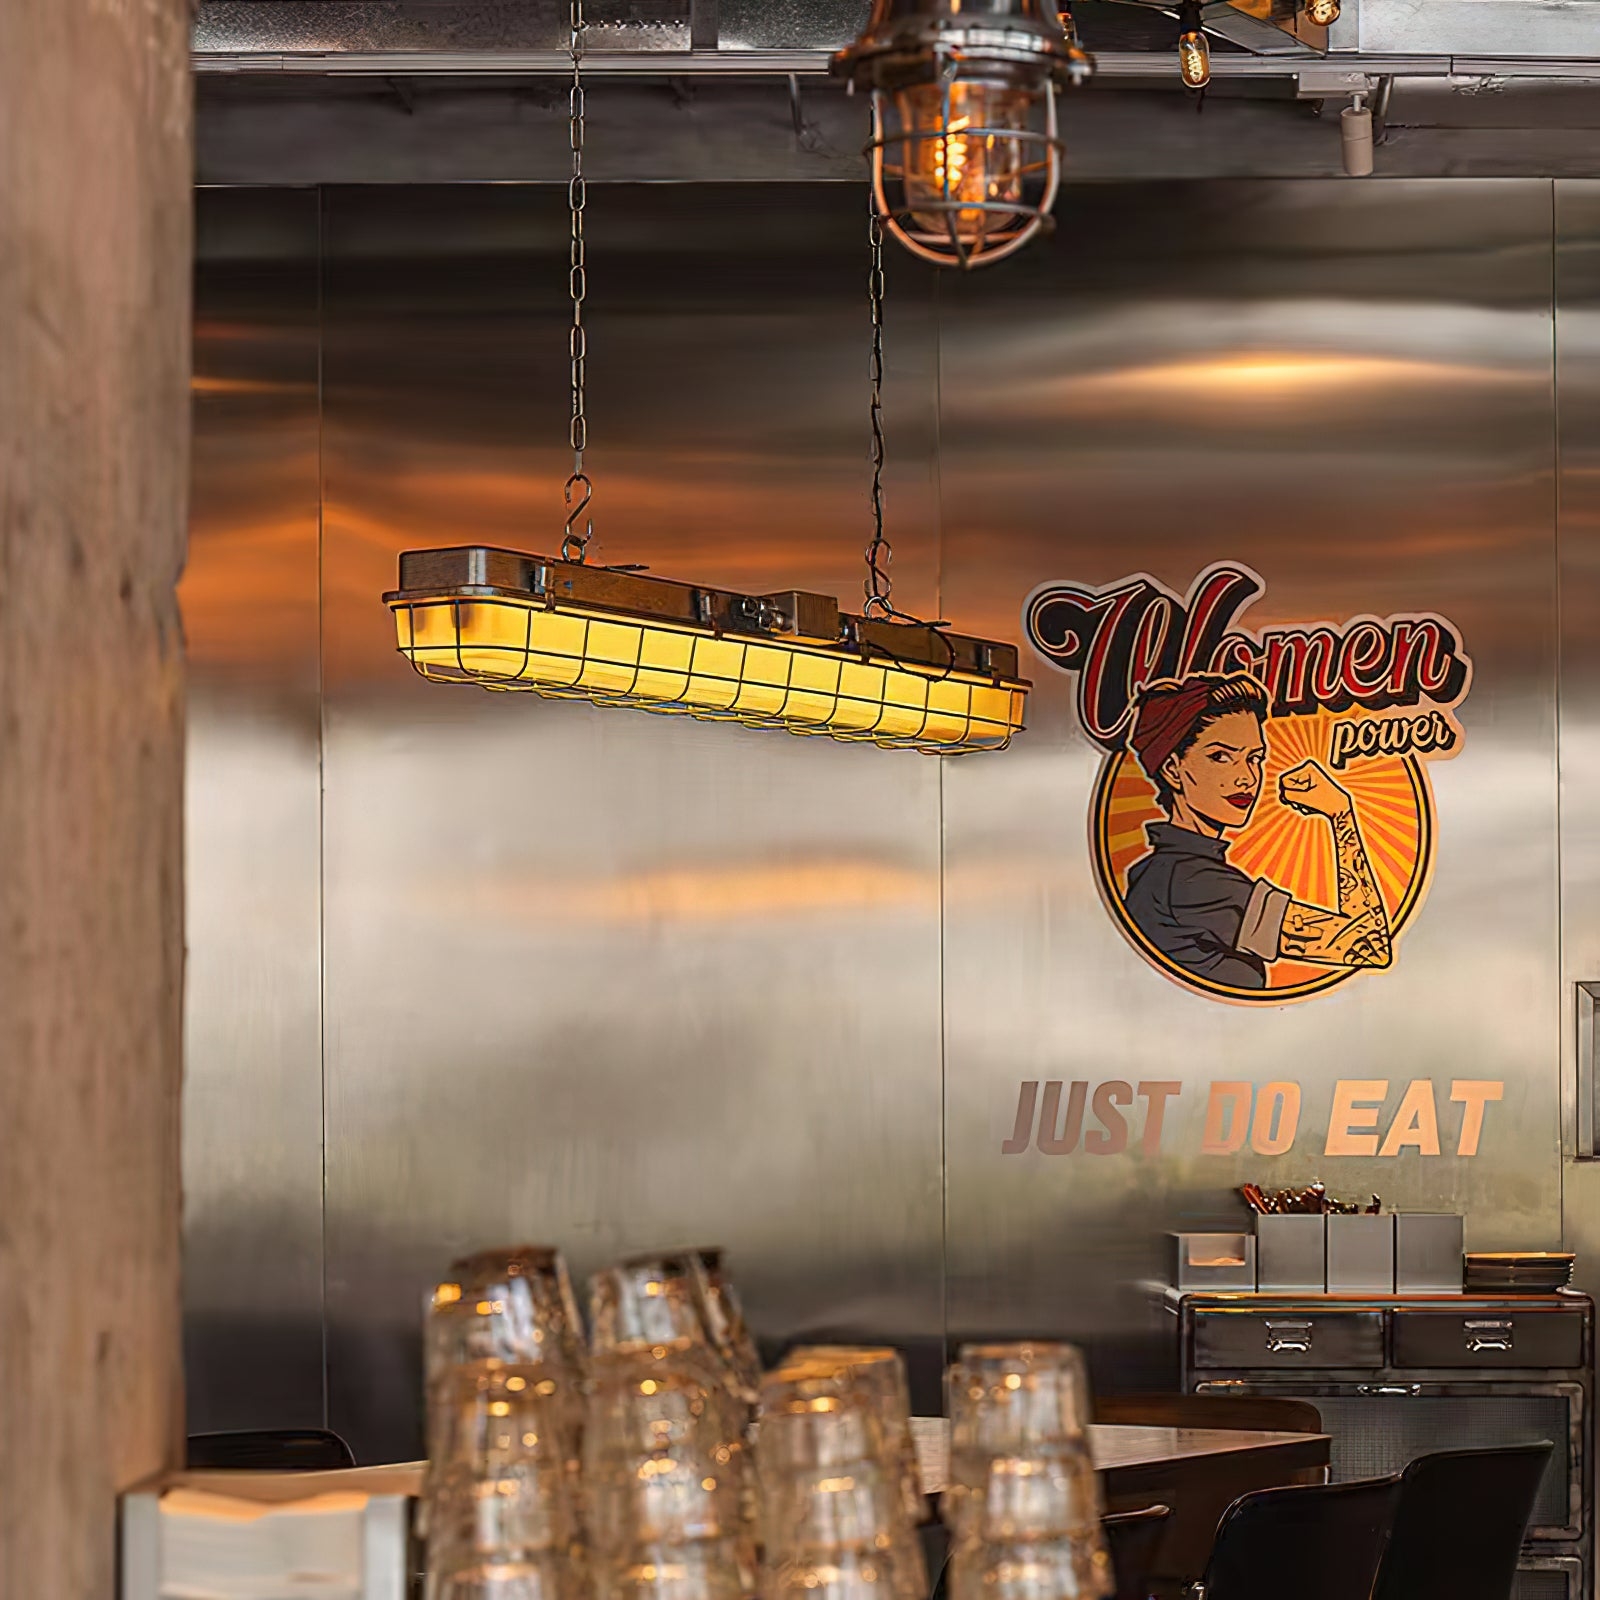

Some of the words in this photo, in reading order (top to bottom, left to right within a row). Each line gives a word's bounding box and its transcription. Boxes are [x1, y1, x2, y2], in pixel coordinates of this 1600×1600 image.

[1026, 566, 1465, 750] Women
[1331, 711, 1457, 768] power
[1001, 1080, 1182, 1156] JUST
[1203, 1080, 1301, 1156] DO
[1324, 1079, 1504, 1156] EAT
